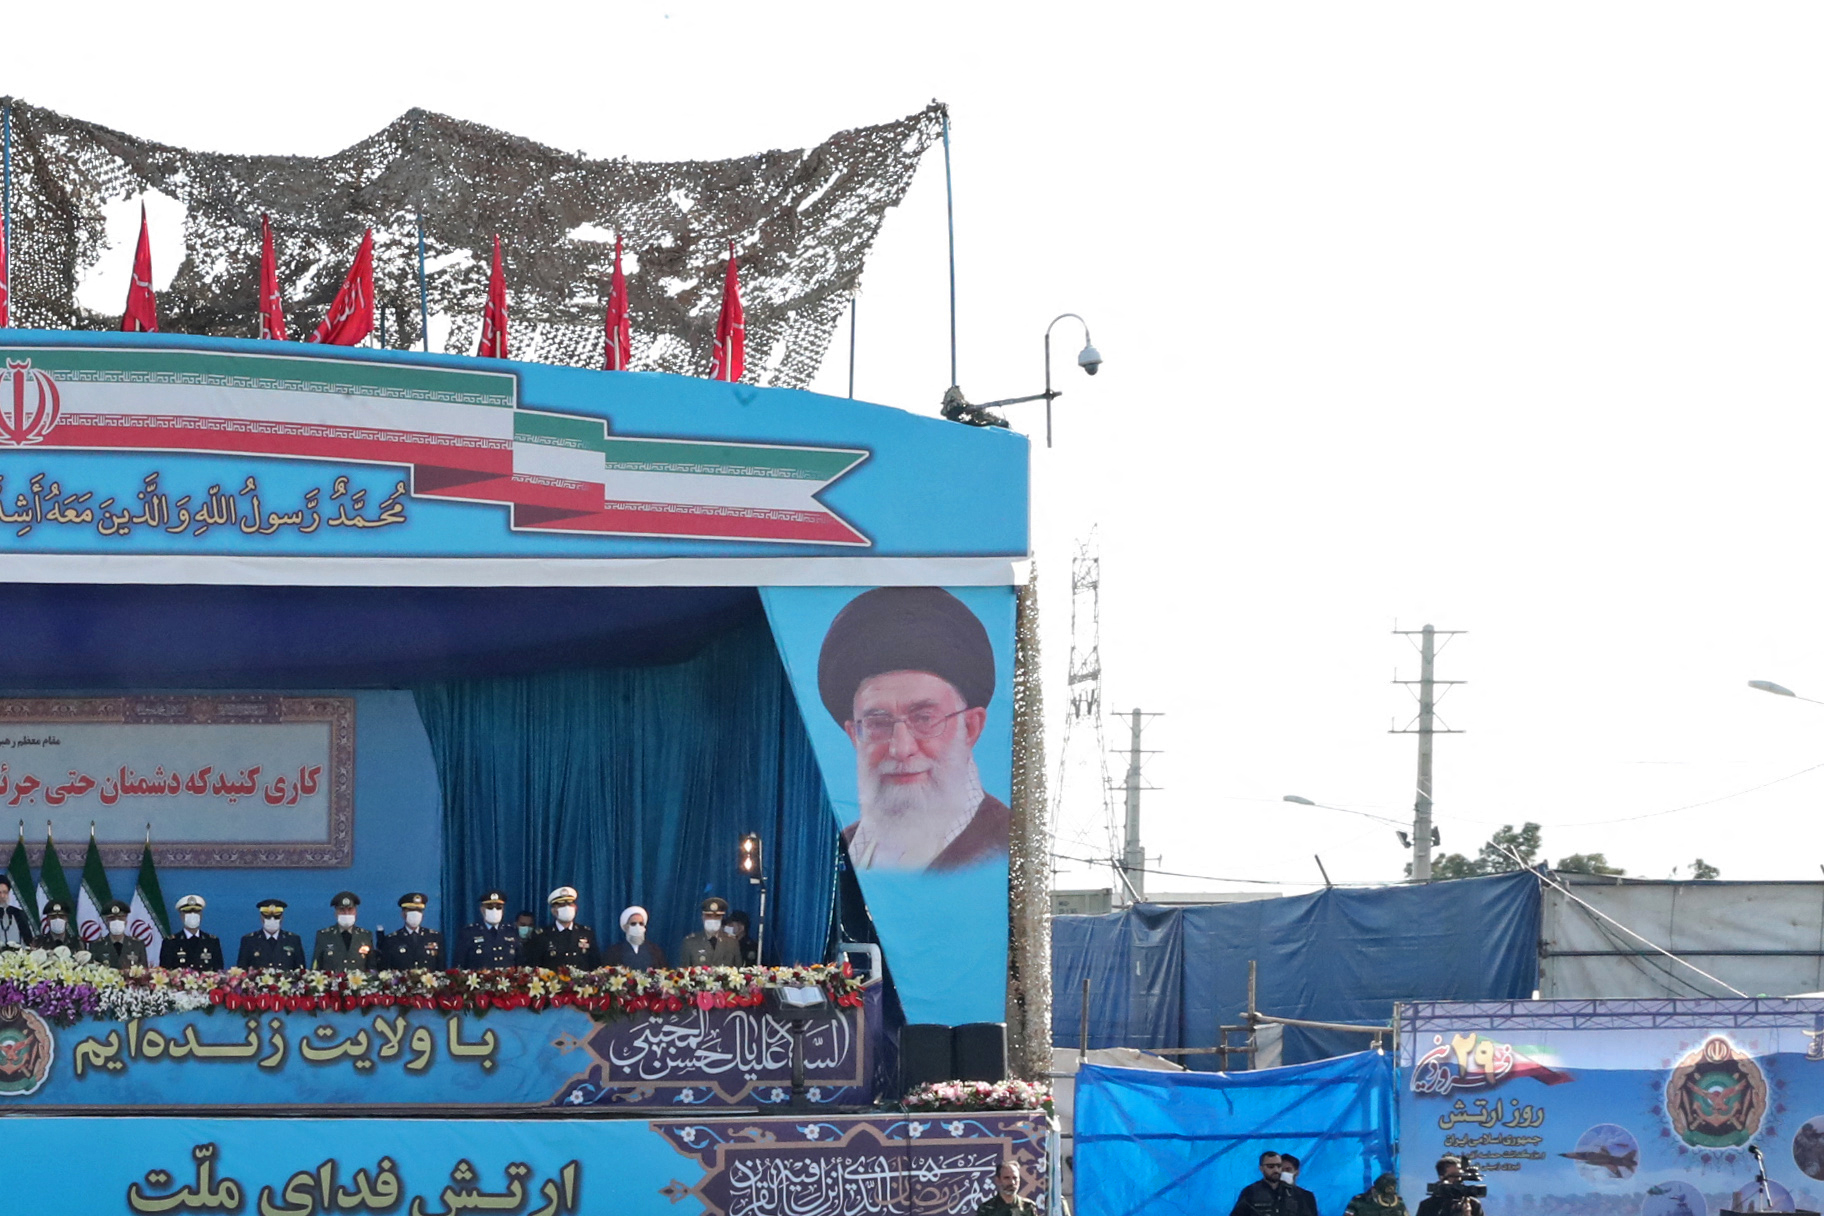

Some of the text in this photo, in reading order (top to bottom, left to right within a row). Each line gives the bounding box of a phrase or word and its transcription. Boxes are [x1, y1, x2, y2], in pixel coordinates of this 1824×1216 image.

[17, 735, 42, 748] معظم
[44, 769, 96, 806] حتی
[99, 763, 183, 806] دشمنان
[184, 765, 213, 797] که
[212, 765, 262, 804] کنید
[264, 765, 322, 806] کاری
[300, 1016, 433, 1070] ولایت
[447, 1015, 497, 1069] با
[1438, 1098, 1544, 1130] روز ارتش
[1444, 1132, 1543, 1148] جمهوری اسلامی ایران
